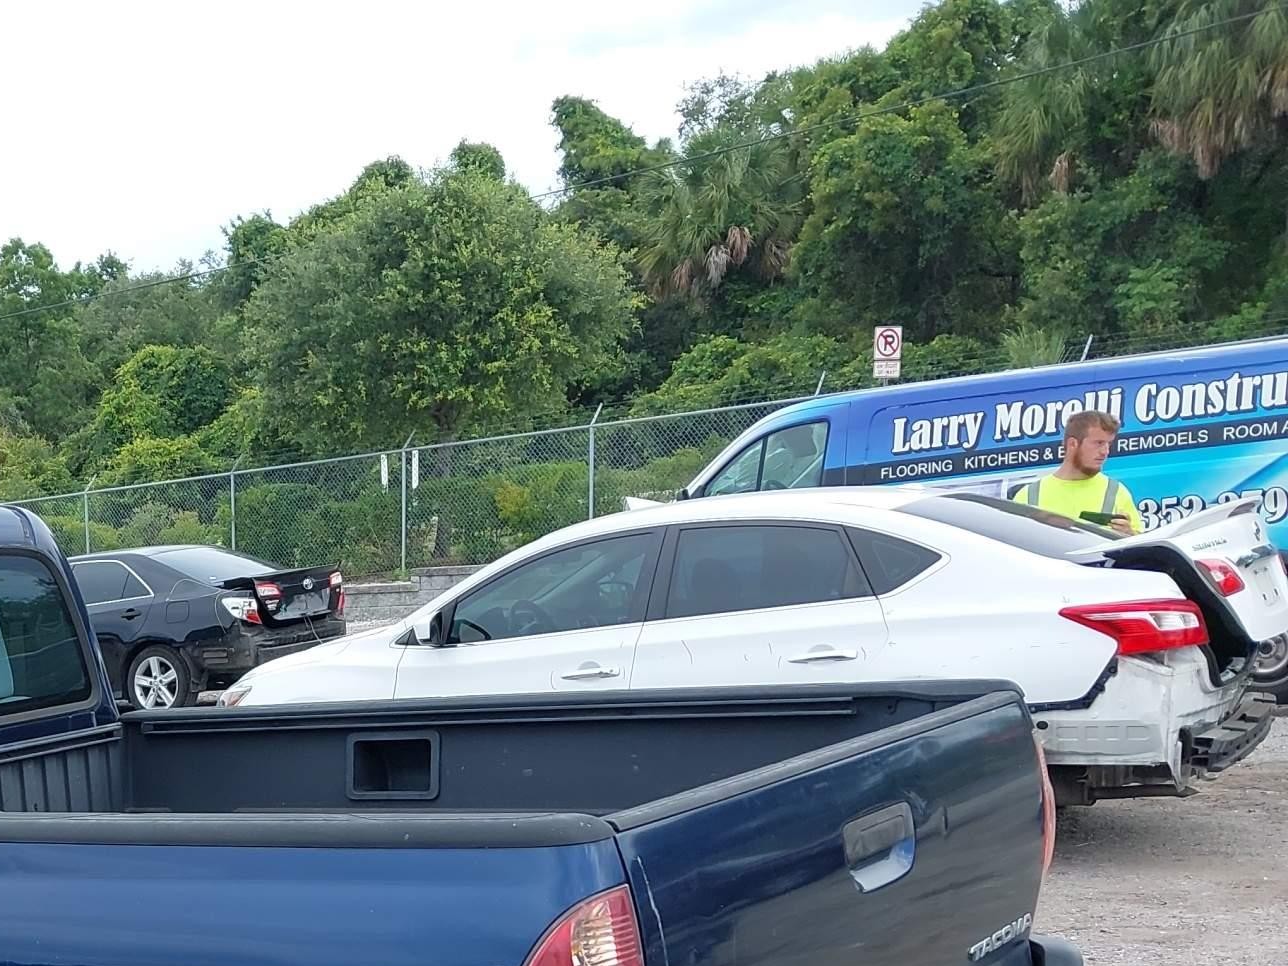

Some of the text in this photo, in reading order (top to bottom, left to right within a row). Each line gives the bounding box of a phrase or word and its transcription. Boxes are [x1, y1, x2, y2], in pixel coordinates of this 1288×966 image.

[891, 410, 985, 454] Larry
[1134, 371, 1288, 423] Constru
[1117, 429, 1209, 452] REMODELS
[1223, 420, 1278, 440] ROOM
[880, 459, 953, 480] FLOORING
[964, 448, 1039, 470] KITCHENS
[1042, 447, 1054, 461] &
[1137, 487, 1288, 532] 352-9
[969, 911, 1032, 961] TACOMA
